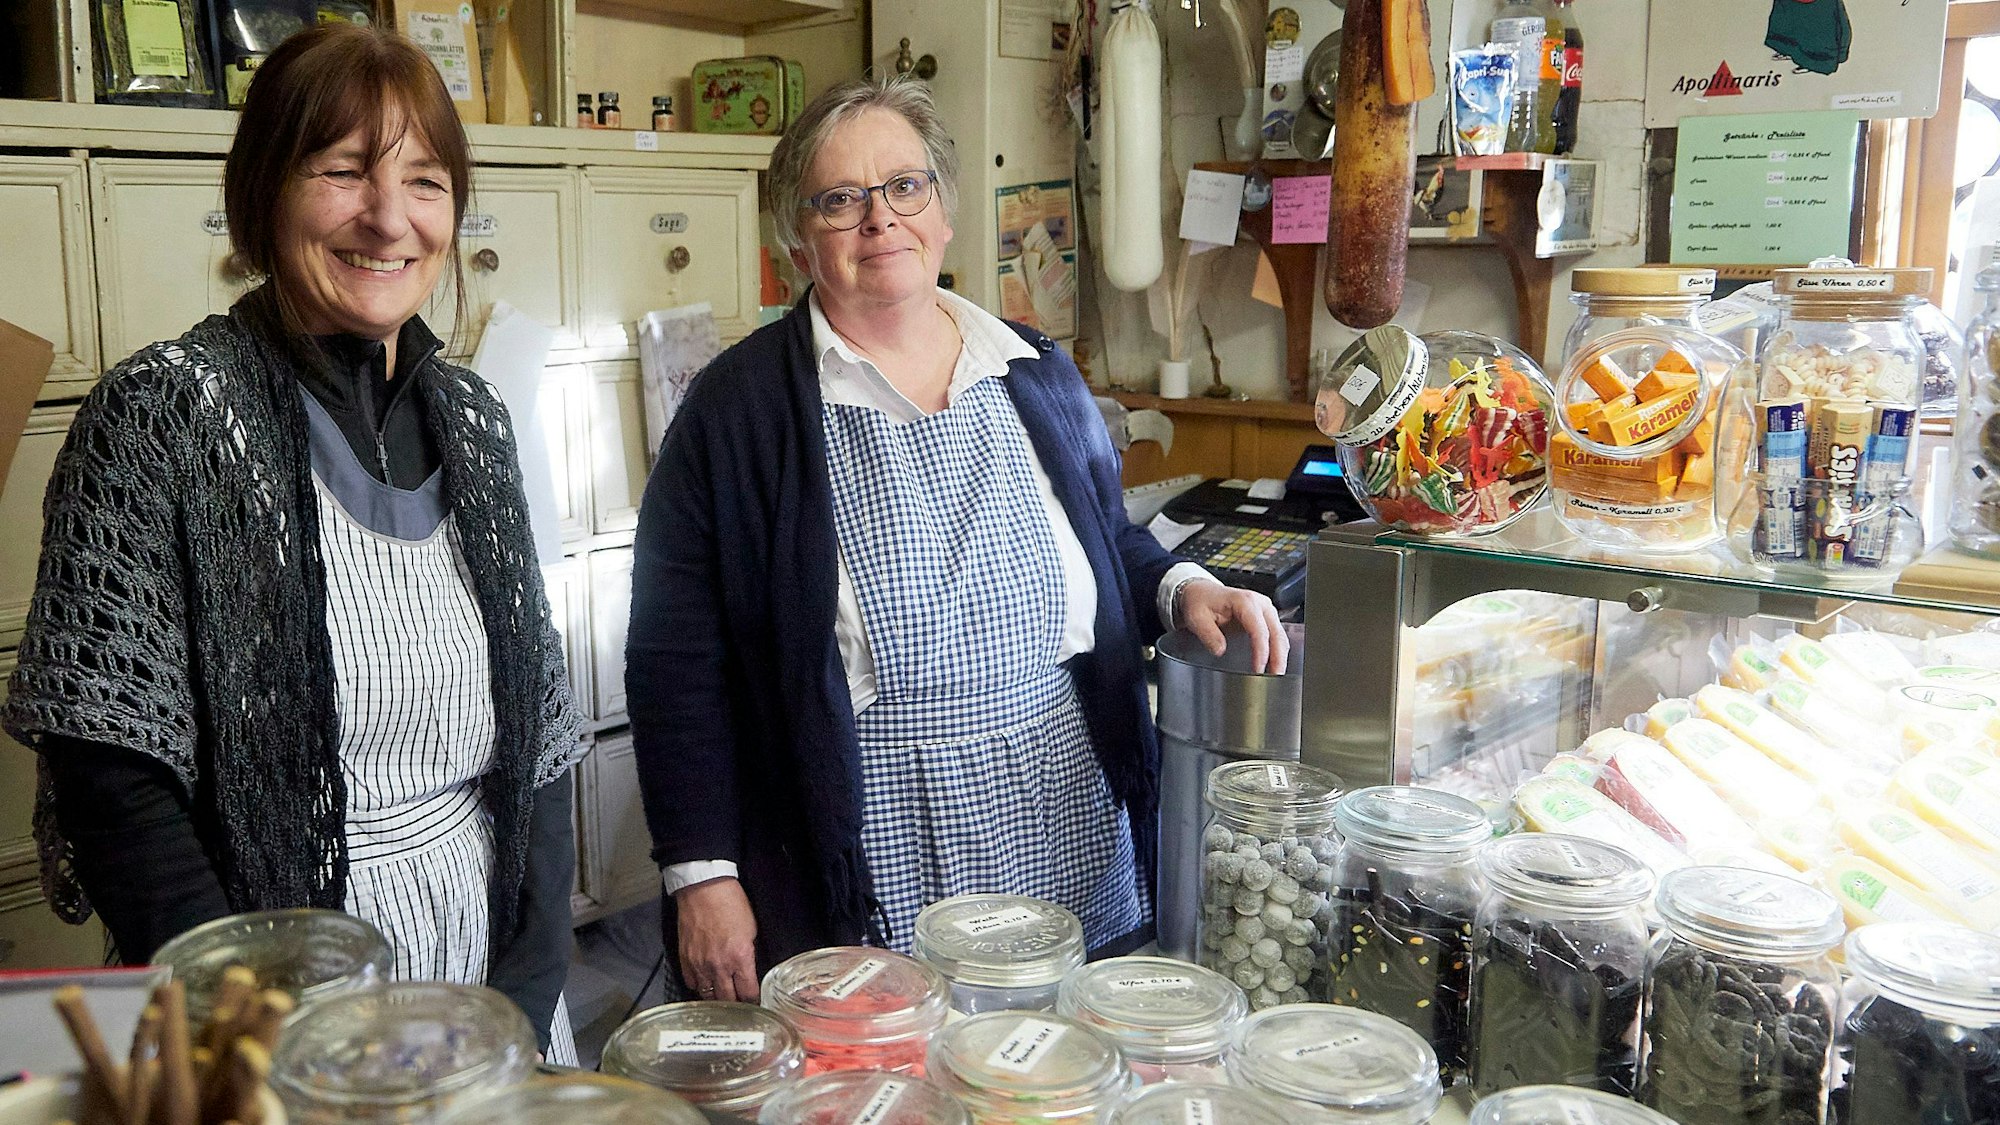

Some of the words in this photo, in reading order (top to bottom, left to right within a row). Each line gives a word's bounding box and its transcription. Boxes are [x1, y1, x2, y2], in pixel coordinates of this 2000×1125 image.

[1672, 71, 1781, 95] Apollinaris
[1879, 279, 1886, 287] €
[1628, 389, 1698, 440] Karamell
[1609, 506, 1653, 515] Karamell
